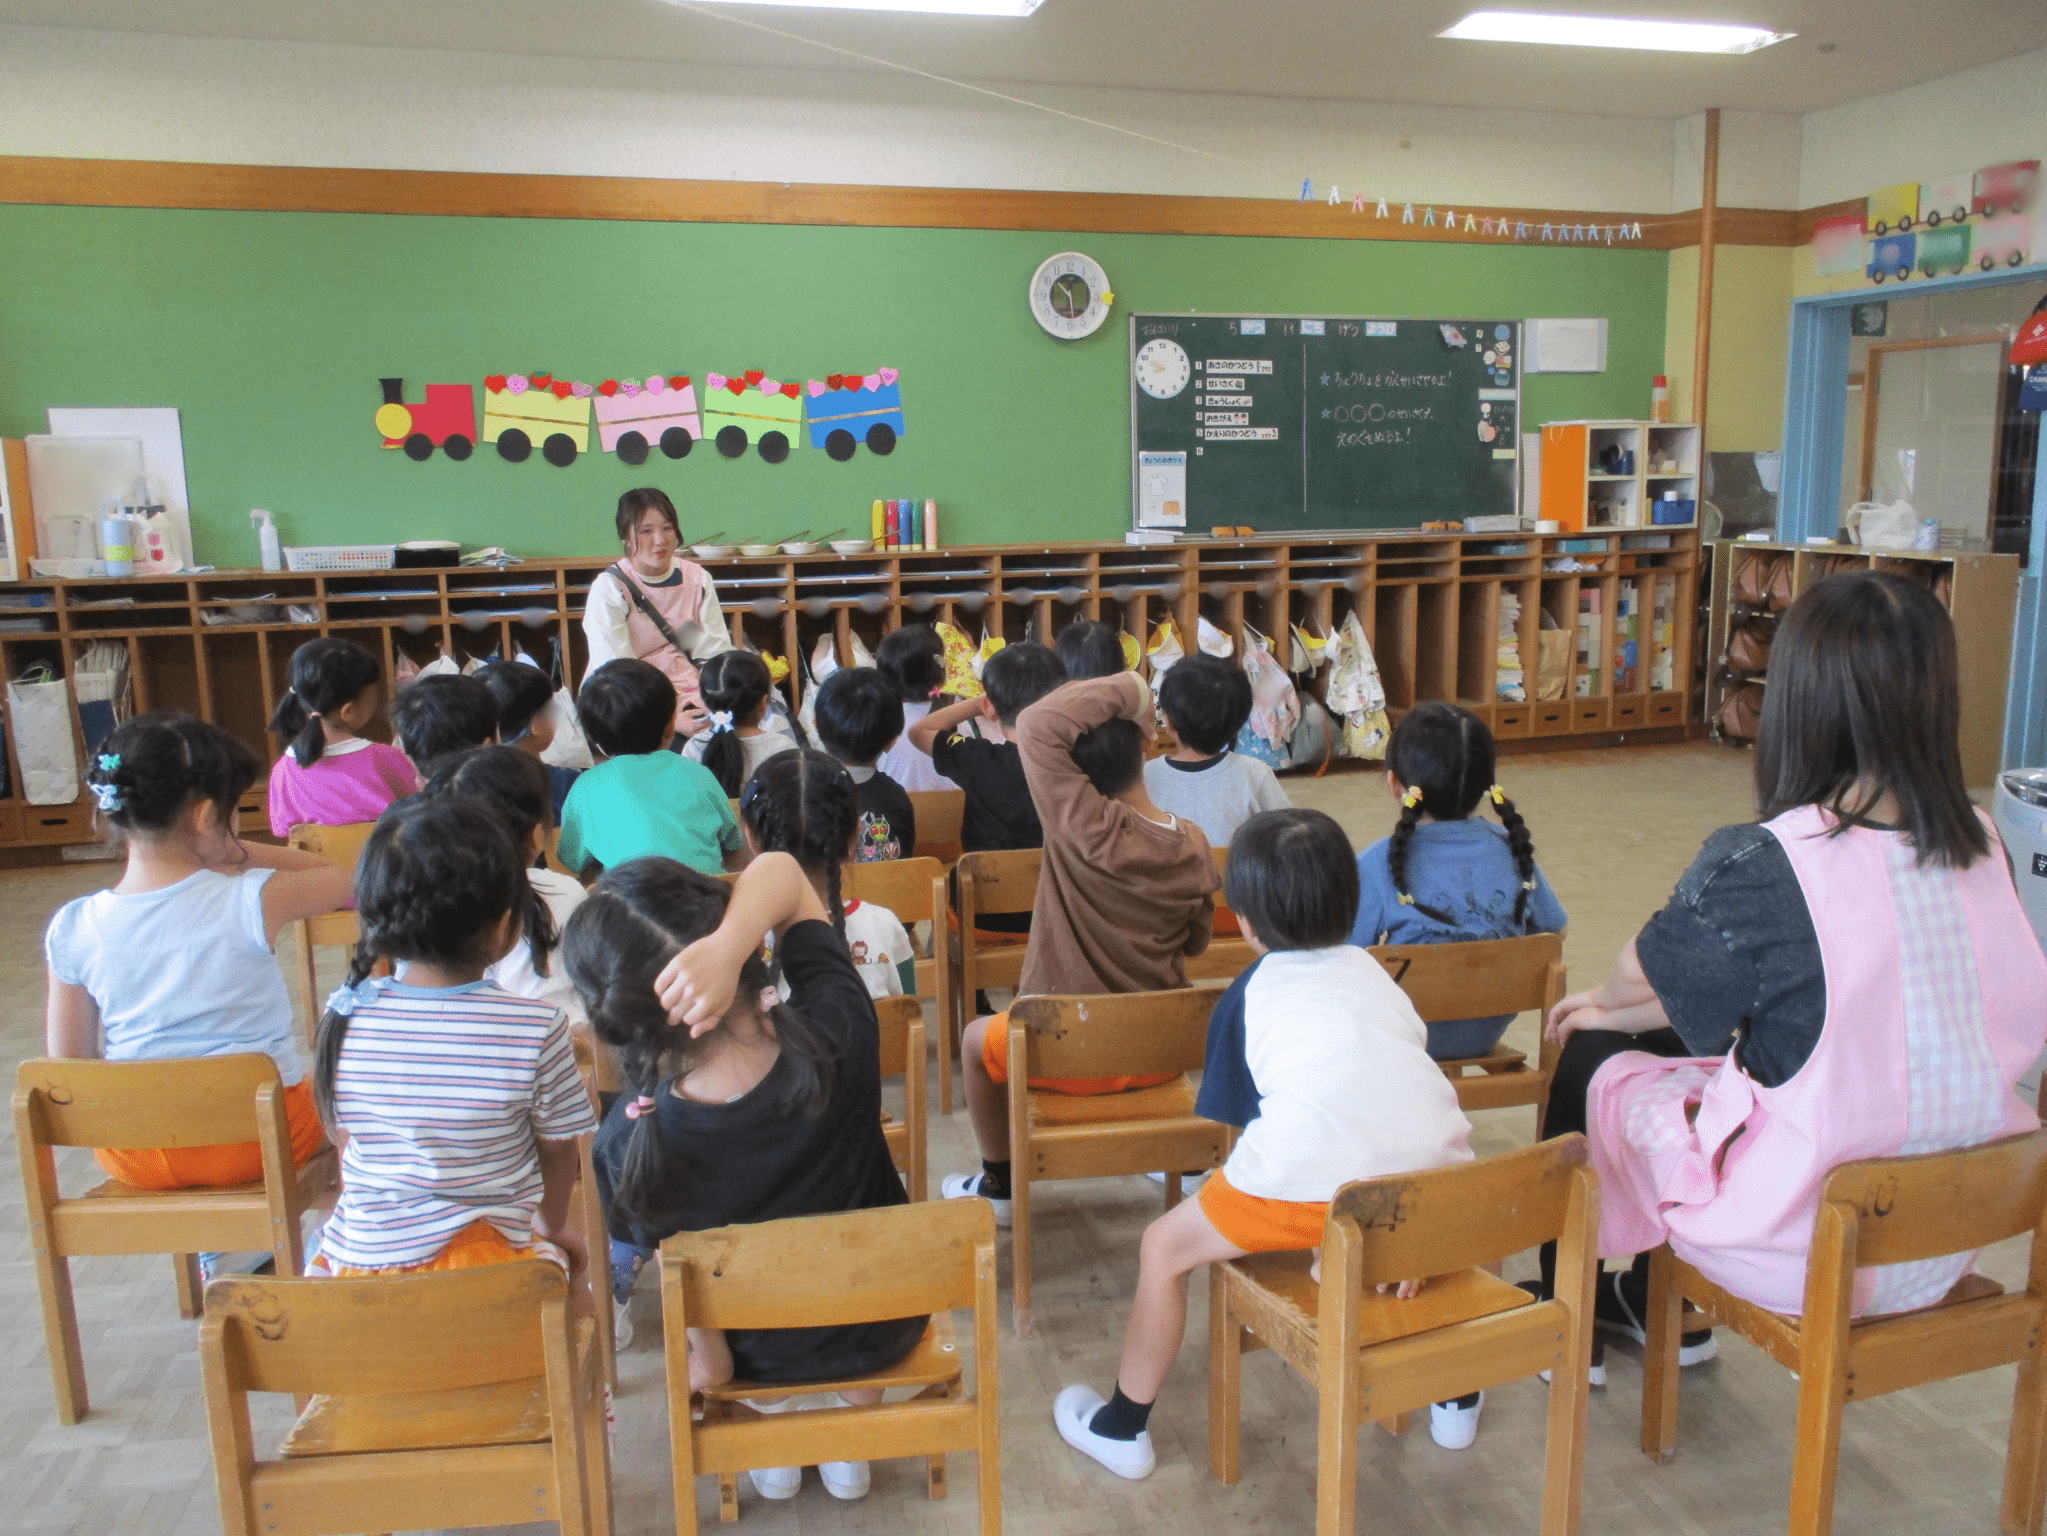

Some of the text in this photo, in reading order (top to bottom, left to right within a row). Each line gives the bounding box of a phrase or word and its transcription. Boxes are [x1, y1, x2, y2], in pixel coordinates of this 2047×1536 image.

[1053, 265, 1060, 276] 11
[1066, 261, 1075, 273] 12
[1043, 276, 1052, 286] 10
[1090, 277, 1096, 288] 2
[1040, 290, 1047, 301] 9
[1093, 292, 1100, 302] 3
[1044, 305, 1050, 316] 8
[1090, 307, 1096, 317] 4
[1054, 315, 1059, 326] 7
[1067, 320, 1073, 331] 6
[1229, 322, 1237, 336] 5
[1208, 361, 1254, 369] あさのかつどう
[1208, 380, 1233, 388] せいさく
[1208, 397, 1241, 405] きゅうしょく
[1206, 430, 1257, 438] かえりのかつどう
[1385, 957, 1412, 984] 7
